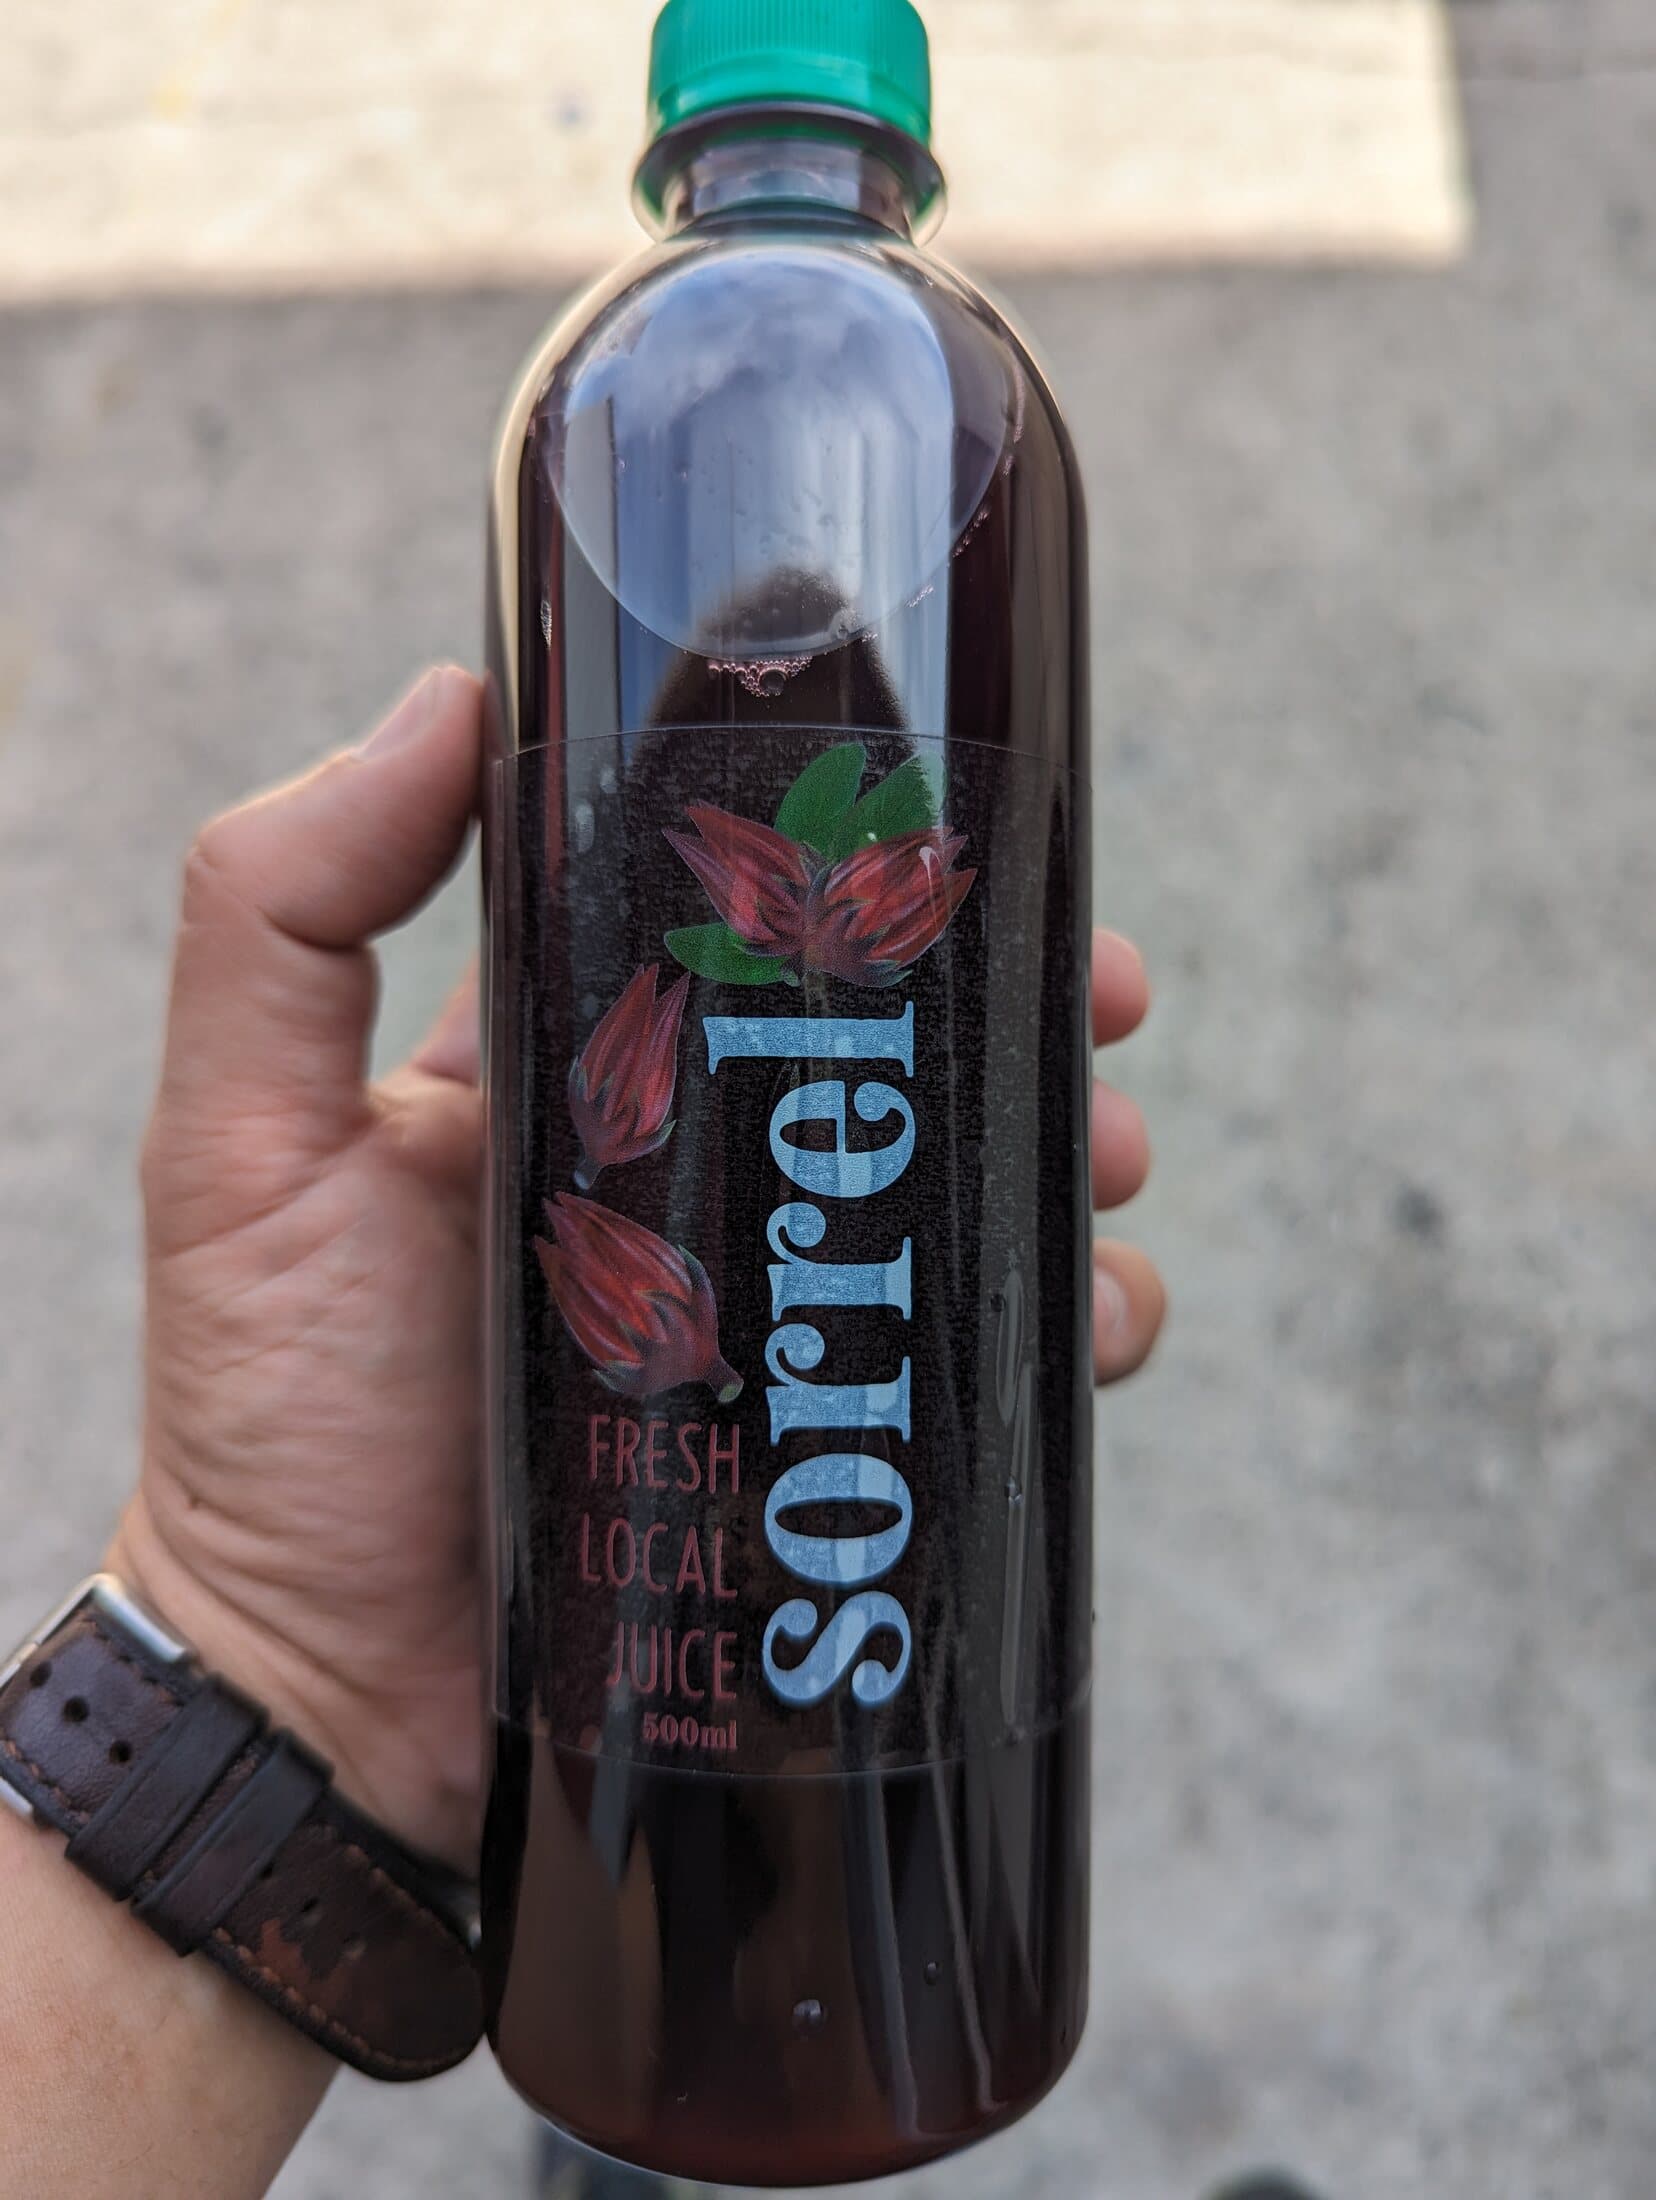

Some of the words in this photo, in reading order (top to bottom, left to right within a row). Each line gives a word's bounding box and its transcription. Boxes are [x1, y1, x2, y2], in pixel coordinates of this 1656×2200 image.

[702, 1000, 916, 1706] sorrel
[587, 1413, 740, 1495] FRESH
[580, 1512, 738, 1600] LOCAL
[606, 1620, 738, 1701] JUICE
[641, 1711, 738, 1751] 500ml
